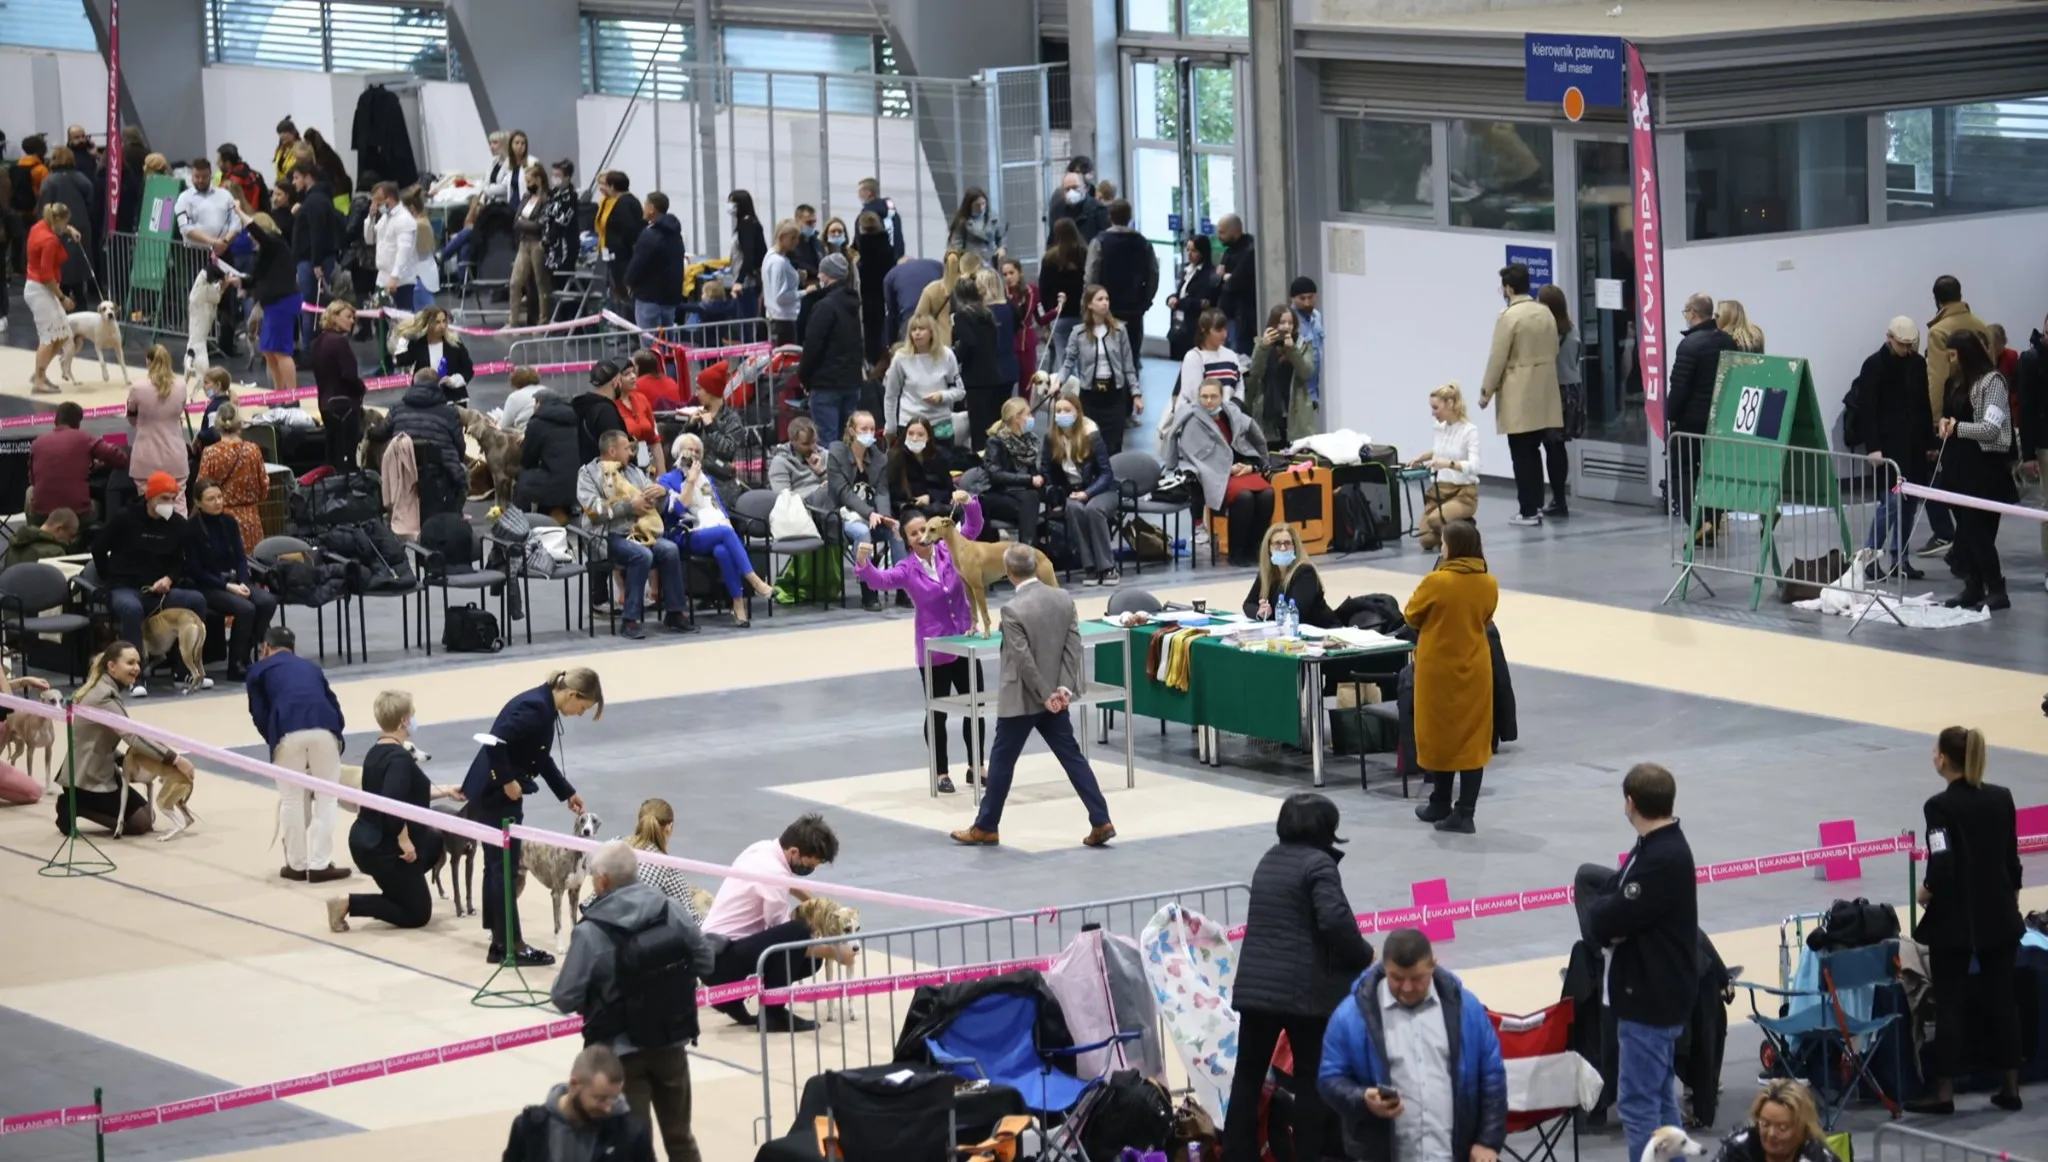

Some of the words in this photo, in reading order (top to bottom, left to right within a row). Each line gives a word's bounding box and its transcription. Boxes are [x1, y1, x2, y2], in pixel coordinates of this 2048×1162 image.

[1532, 42, 1573, 57] kierownik
[1575, 45, 1615, 60] pawilonu
[1554, 62, 1567, 72] hall
[1568, 64, 1593, 74] master
[1736, 388, 1760, 431] 38
[1713, 862, 1755, 875] EUKANUBA
[1759, 855, 1801, 868] EUKANUBA
[1806, 848, 1848, 861] EUKANUBA
[1852, 841, 1895, 854] EUKANUBA
[1378, 912, 1422, 926] EUKANUBA
[1427, 906, 1470, 919] EUKANUBA
[1475, 899, 1518, 912] EUKANUBA
[1523, 892, 1566, 905] EUKANUBA
[709, 984, 757, 999] EUKANUBA
[162, 1099, 214, 1115] EUKANUBA
[219, 1086, 271, 1103] EUKANUBA
[275, 1075, 327, 1091] EUKANUBA
[331, 1063, 382, 1079] EUKANUBA
[387, 1052, 437, 1068] EUKANUBA
[442, 1039, 492, 1056] EUKANUBA
[496, 1028, 546, 1044] EUKANUBA
[5, 1117, 60, 1133] EUKANUBA
